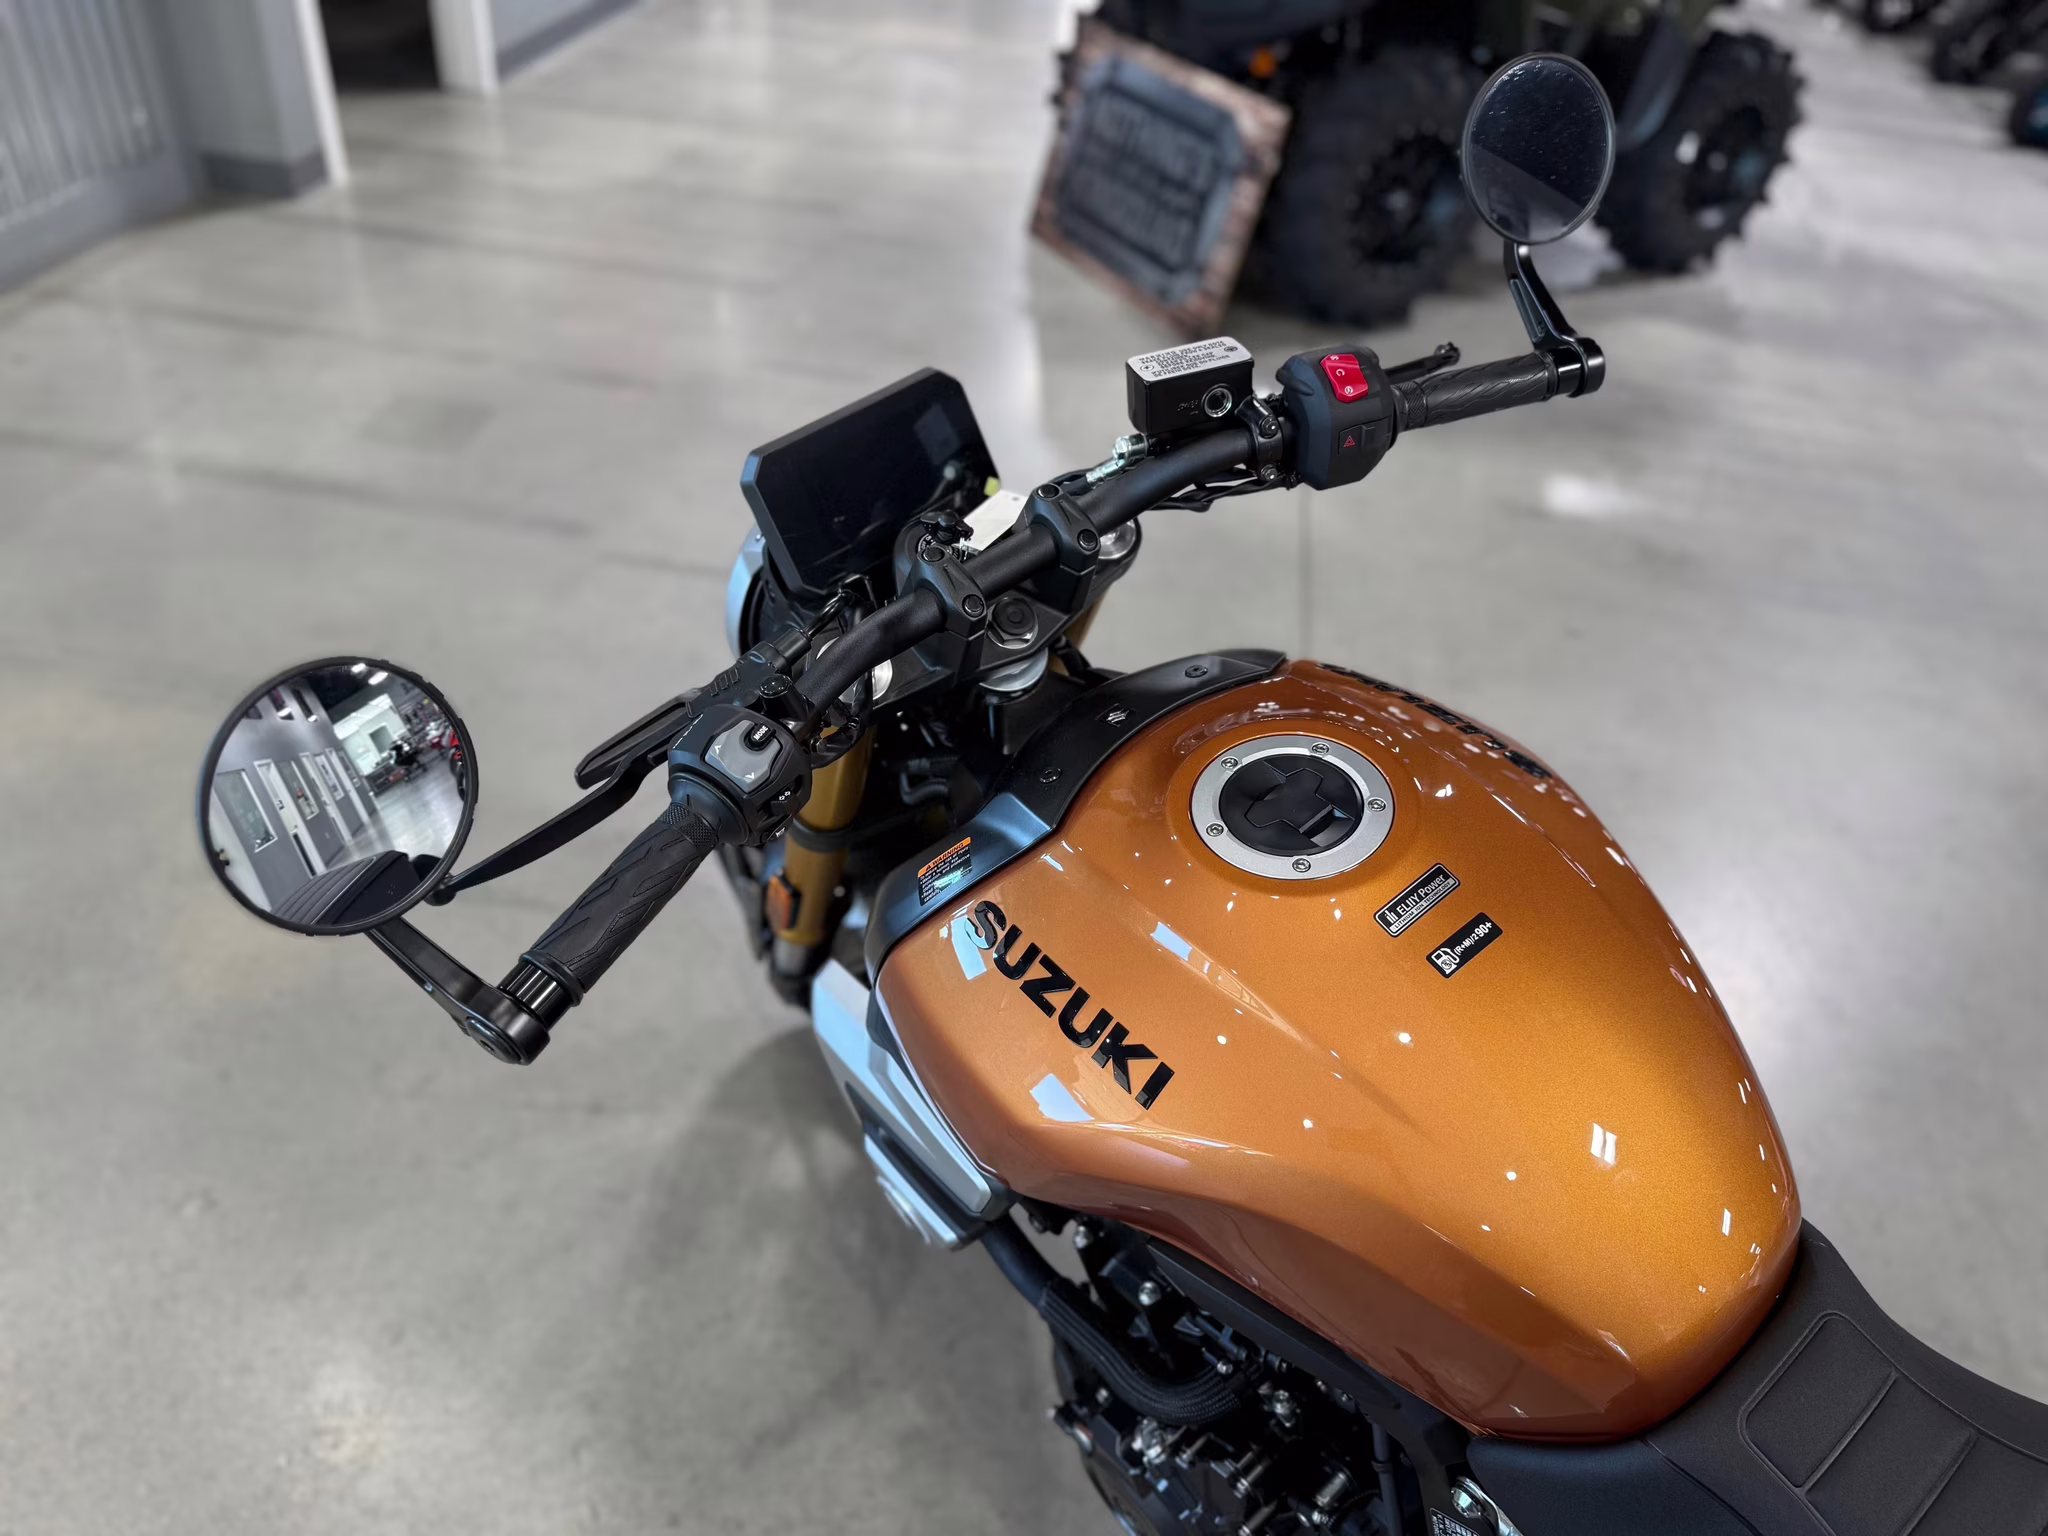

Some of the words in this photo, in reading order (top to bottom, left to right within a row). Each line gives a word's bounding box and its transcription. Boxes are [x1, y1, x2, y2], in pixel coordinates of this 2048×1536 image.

[753, 725, 769, 741] MODE
[932, 843, 963, 866] WARNING
[1395, 911, 1415, 928] LITHIUM
[1414, 903, 1425, 913] ION
[1424, 881, 1451, 904] TECHNOLOGY
[1396, 893, 1420, 916] ELIIY
[1418, 874, 1446, 898] Power
[964, 900, 1175, 1110] SUZUKI
